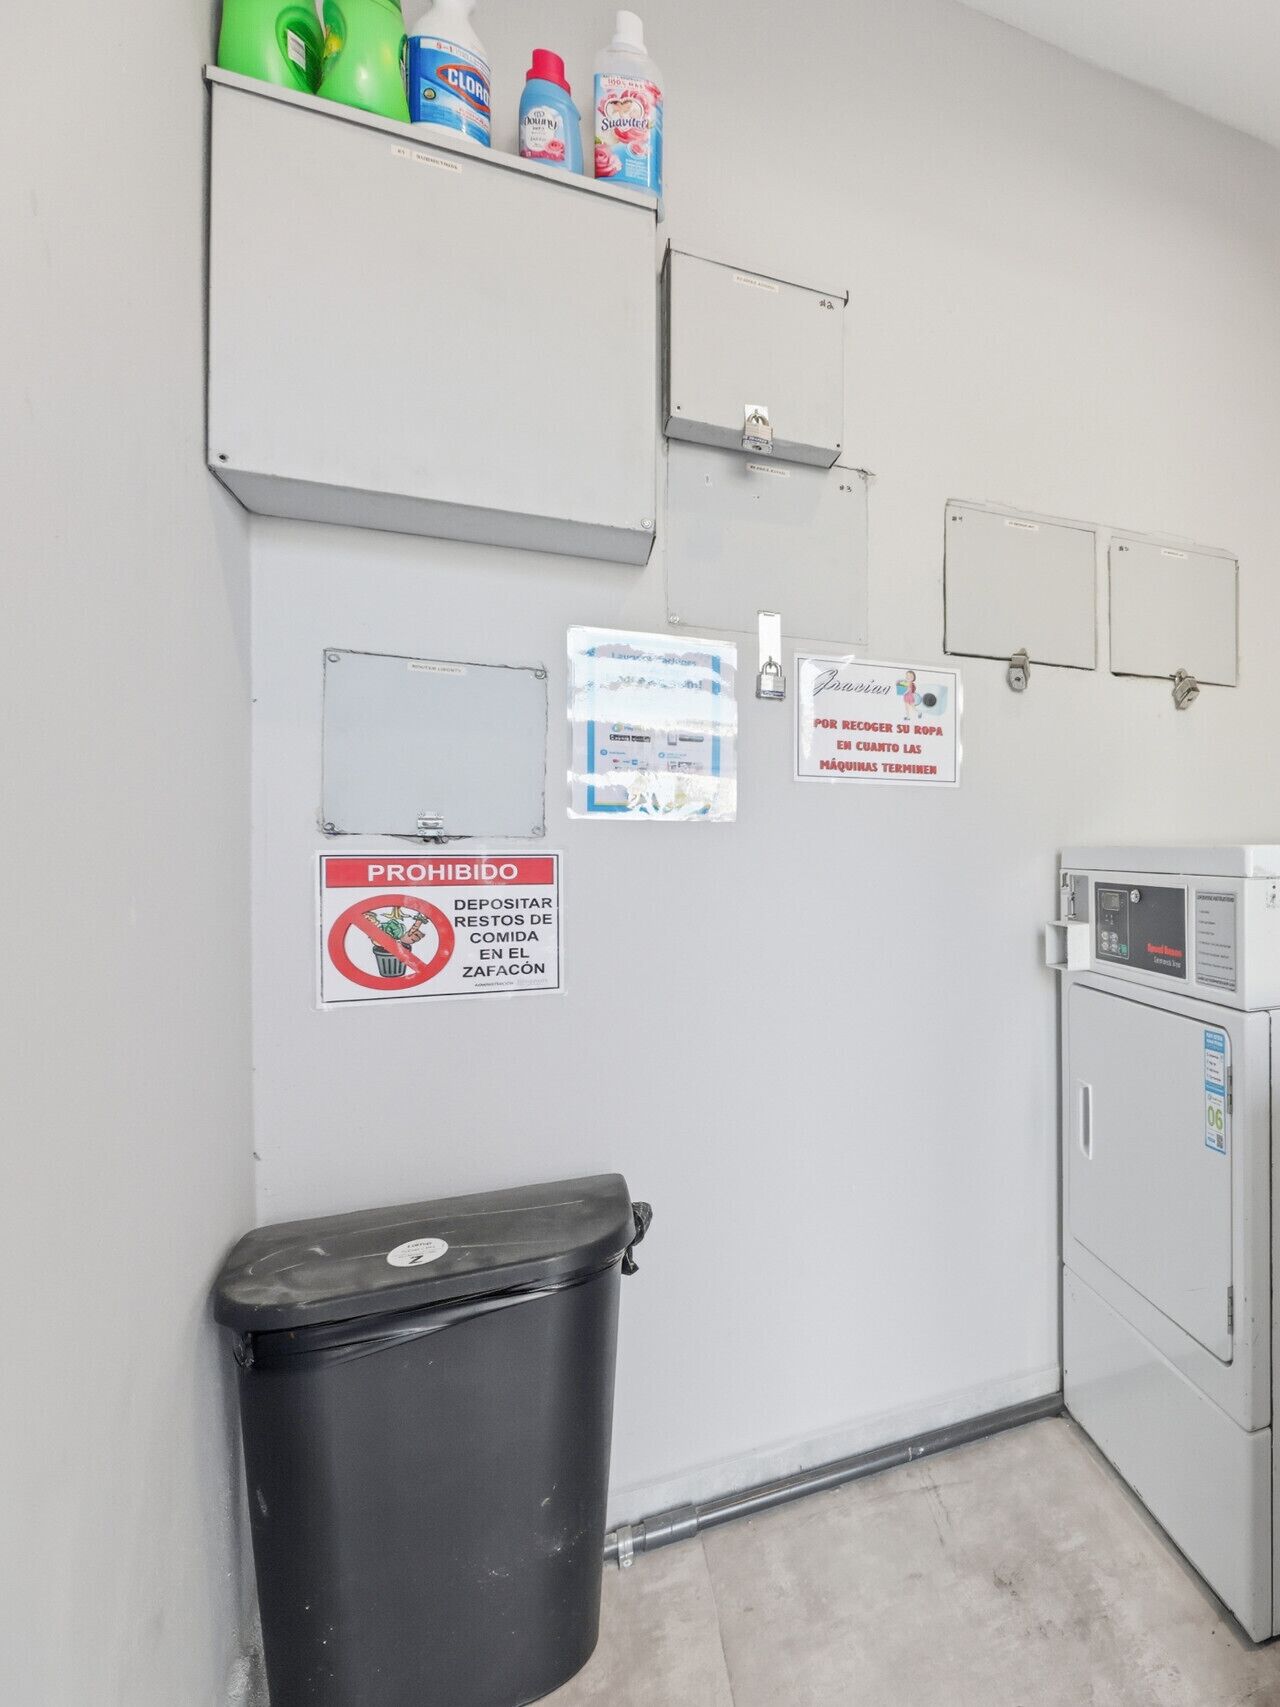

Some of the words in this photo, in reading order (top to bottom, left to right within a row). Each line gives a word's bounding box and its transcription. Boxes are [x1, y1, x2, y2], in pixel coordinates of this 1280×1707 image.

[813, 669, 892, 696] Gracias
[814, 718, 837, 730] POR
[842, 719, 893, 733] RECOGER
[896, 723, 910, 735] SU
[914, 725, 943, 736] ROPA
[836, 740, 851, 750] EN
[856, 740, 900, 753] CUANTO
[903, 743, 922, 754] LAS
[819, 757, 879, 774] MÁQUINAS
[881, 762, 937, 775] TERMINEN
[368, 863, 519, 882] PROHIBIDO
[454, 897, 553, 911] DEPOSITAR
[455, 915, 525, 927] RESTOS
[530, 913, 553, 925] DE
[470, 931, 539, 944] COMIDA
[480, 948, 503, 960] EN
[509, 947, 530, 959] EL
[462, 961, 545, 978] ZAFACÓN
[1208, 1105, 1224, 1130] 06
